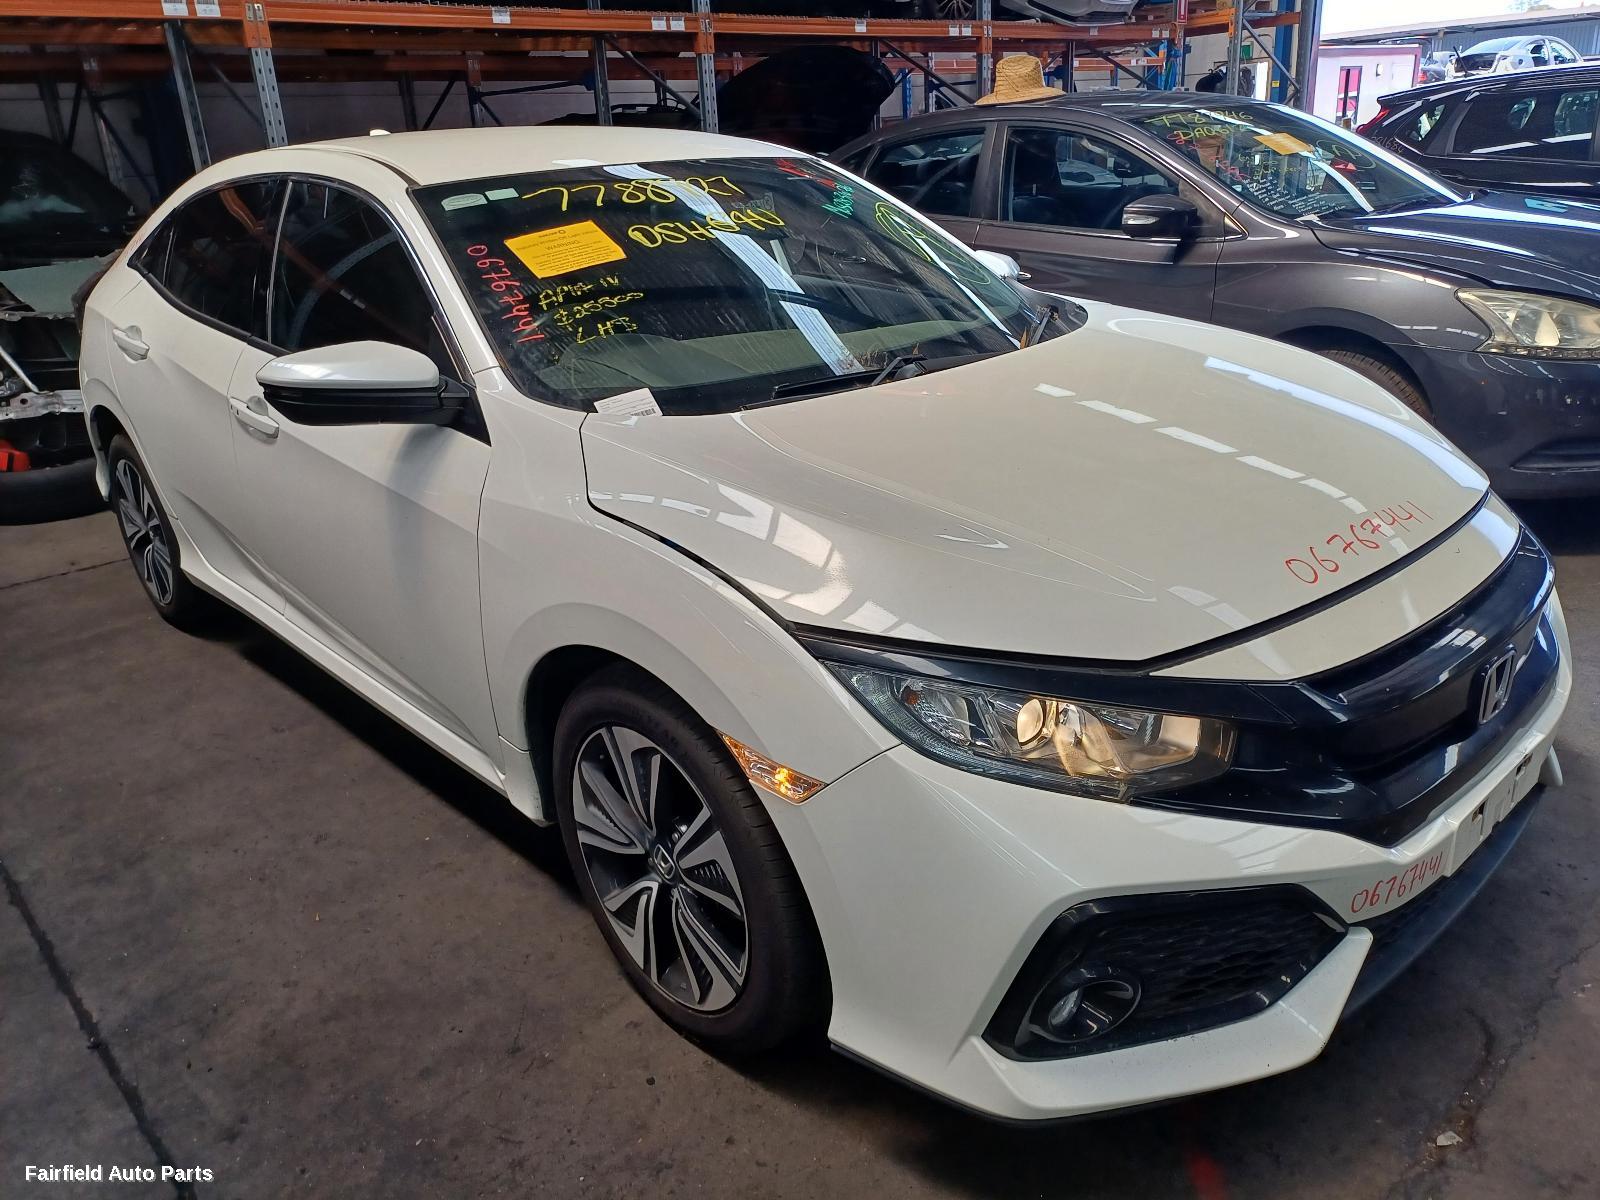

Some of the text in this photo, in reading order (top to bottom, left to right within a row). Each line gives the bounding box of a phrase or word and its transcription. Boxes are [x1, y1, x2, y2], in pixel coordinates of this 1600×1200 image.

[467, 245, 545, 343] 06767441
[1285, 500, 1434, 584] 06767441
[1351, 851, 1443, 913] 06767441
